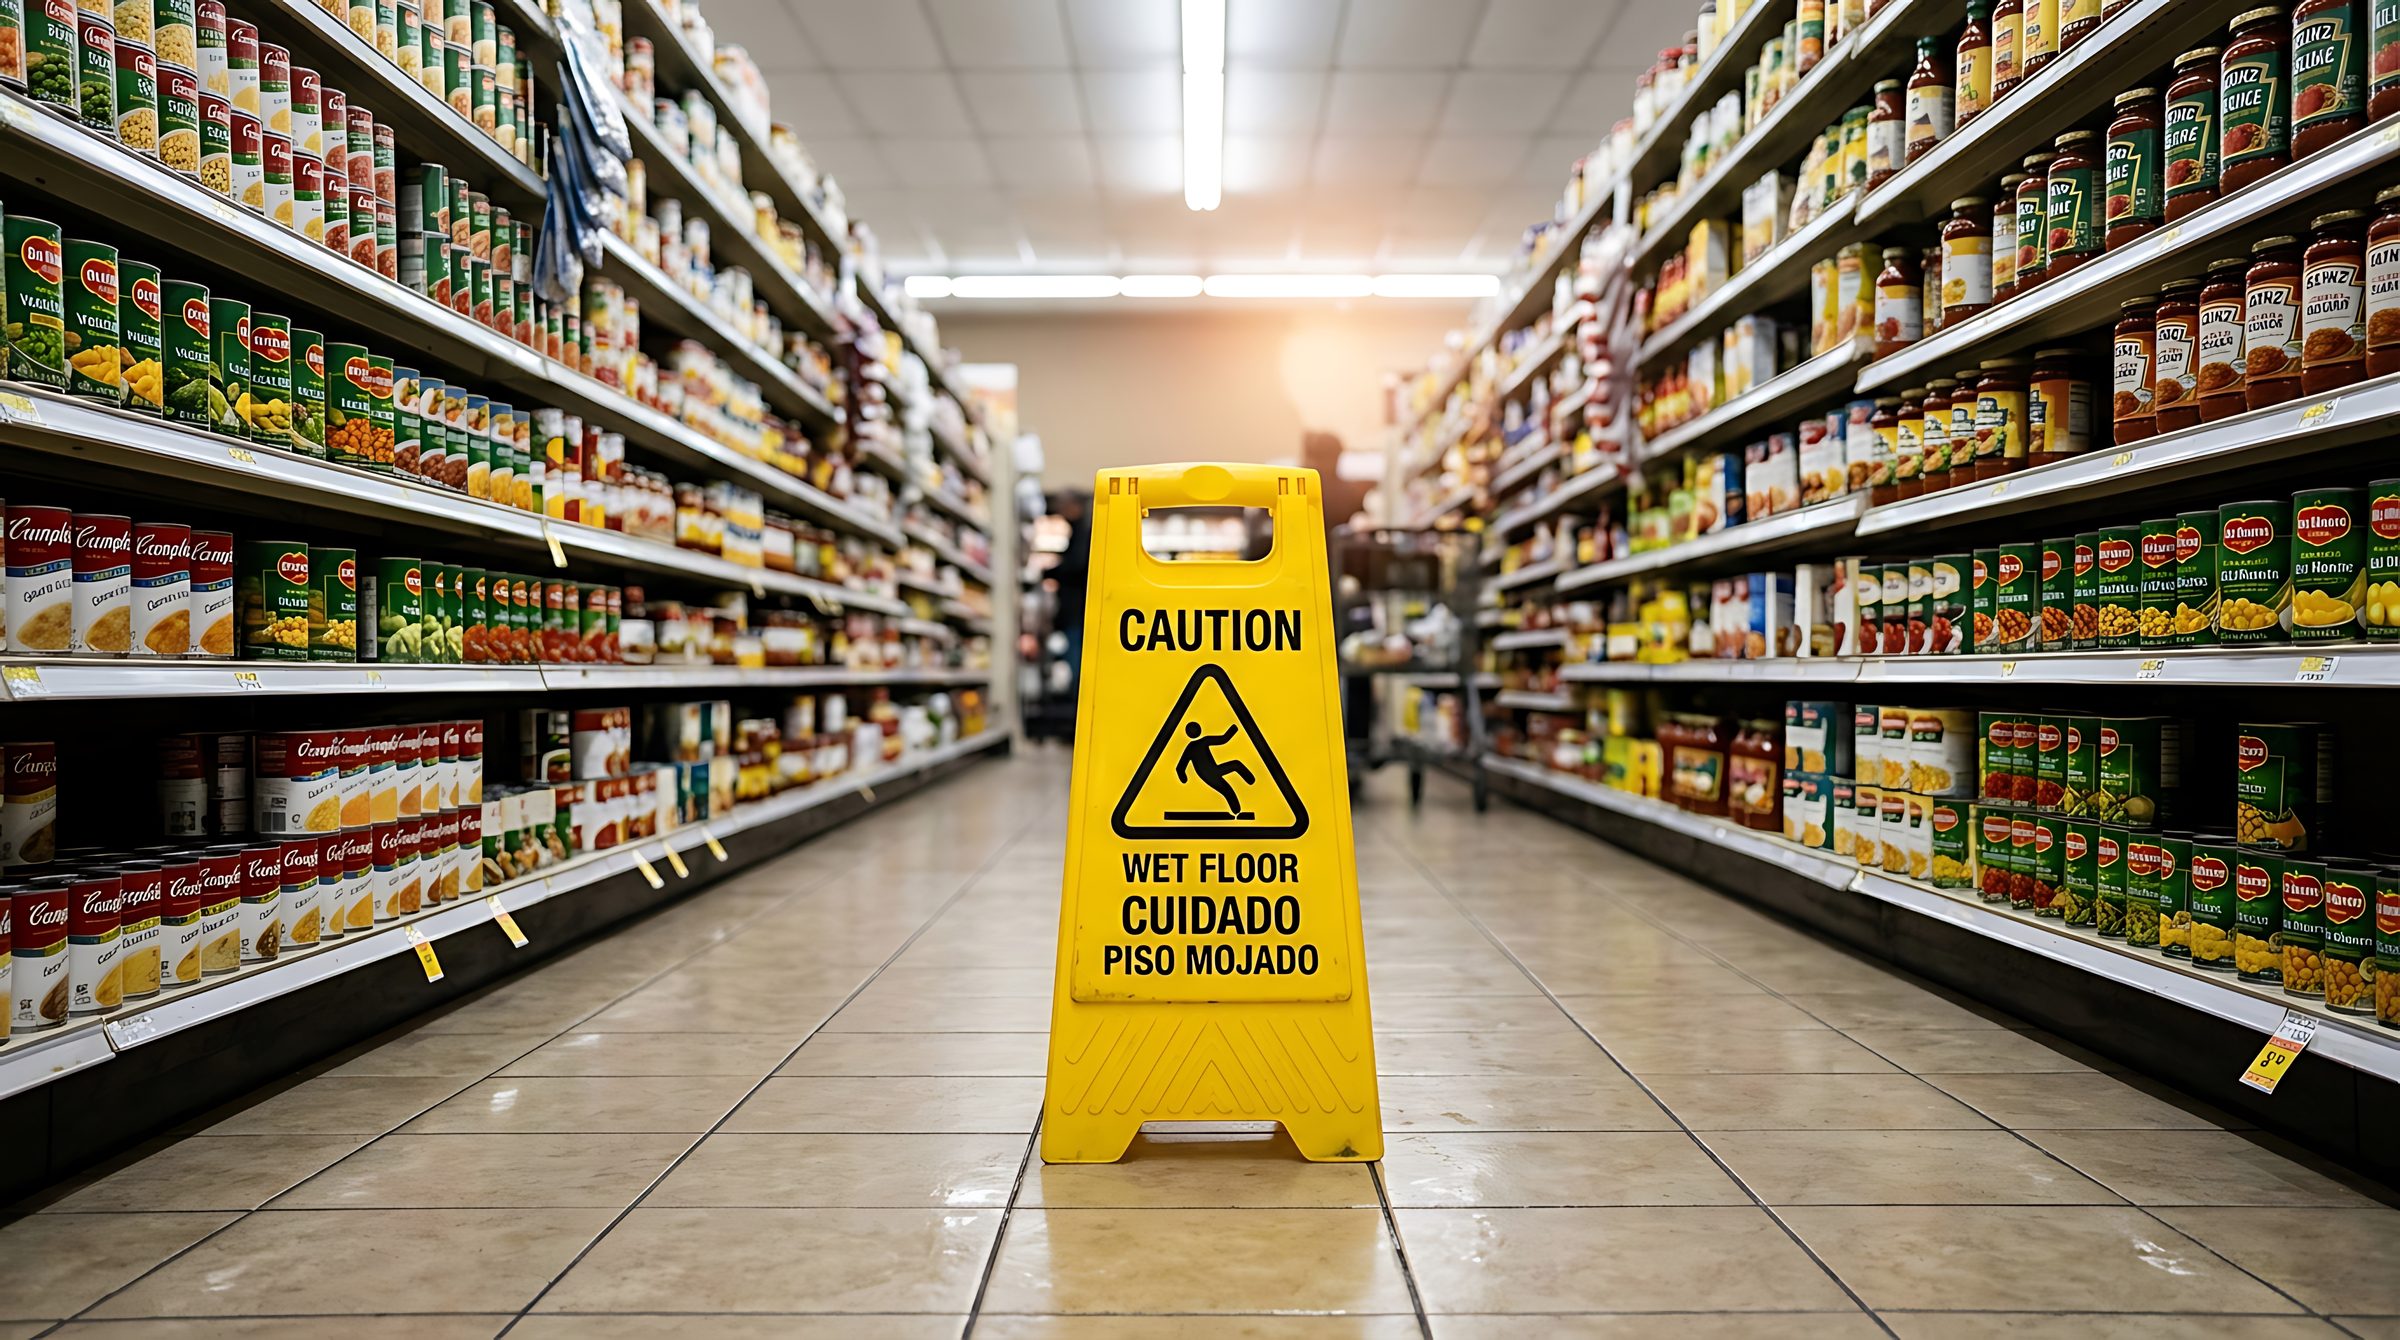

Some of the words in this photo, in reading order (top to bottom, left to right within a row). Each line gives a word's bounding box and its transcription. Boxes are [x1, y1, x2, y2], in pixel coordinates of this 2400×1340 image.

[1120, 609, 1302, 652] CAUTION
[1122, 853, 1189, 883] WET
[1200, 853, 1299, 883] FLOOR
[1122, 896, 1300, 936] CUIDADO
[1104, 945, 1175, 975] PISO
[1186, 945, 1319, 976] MOJADO
